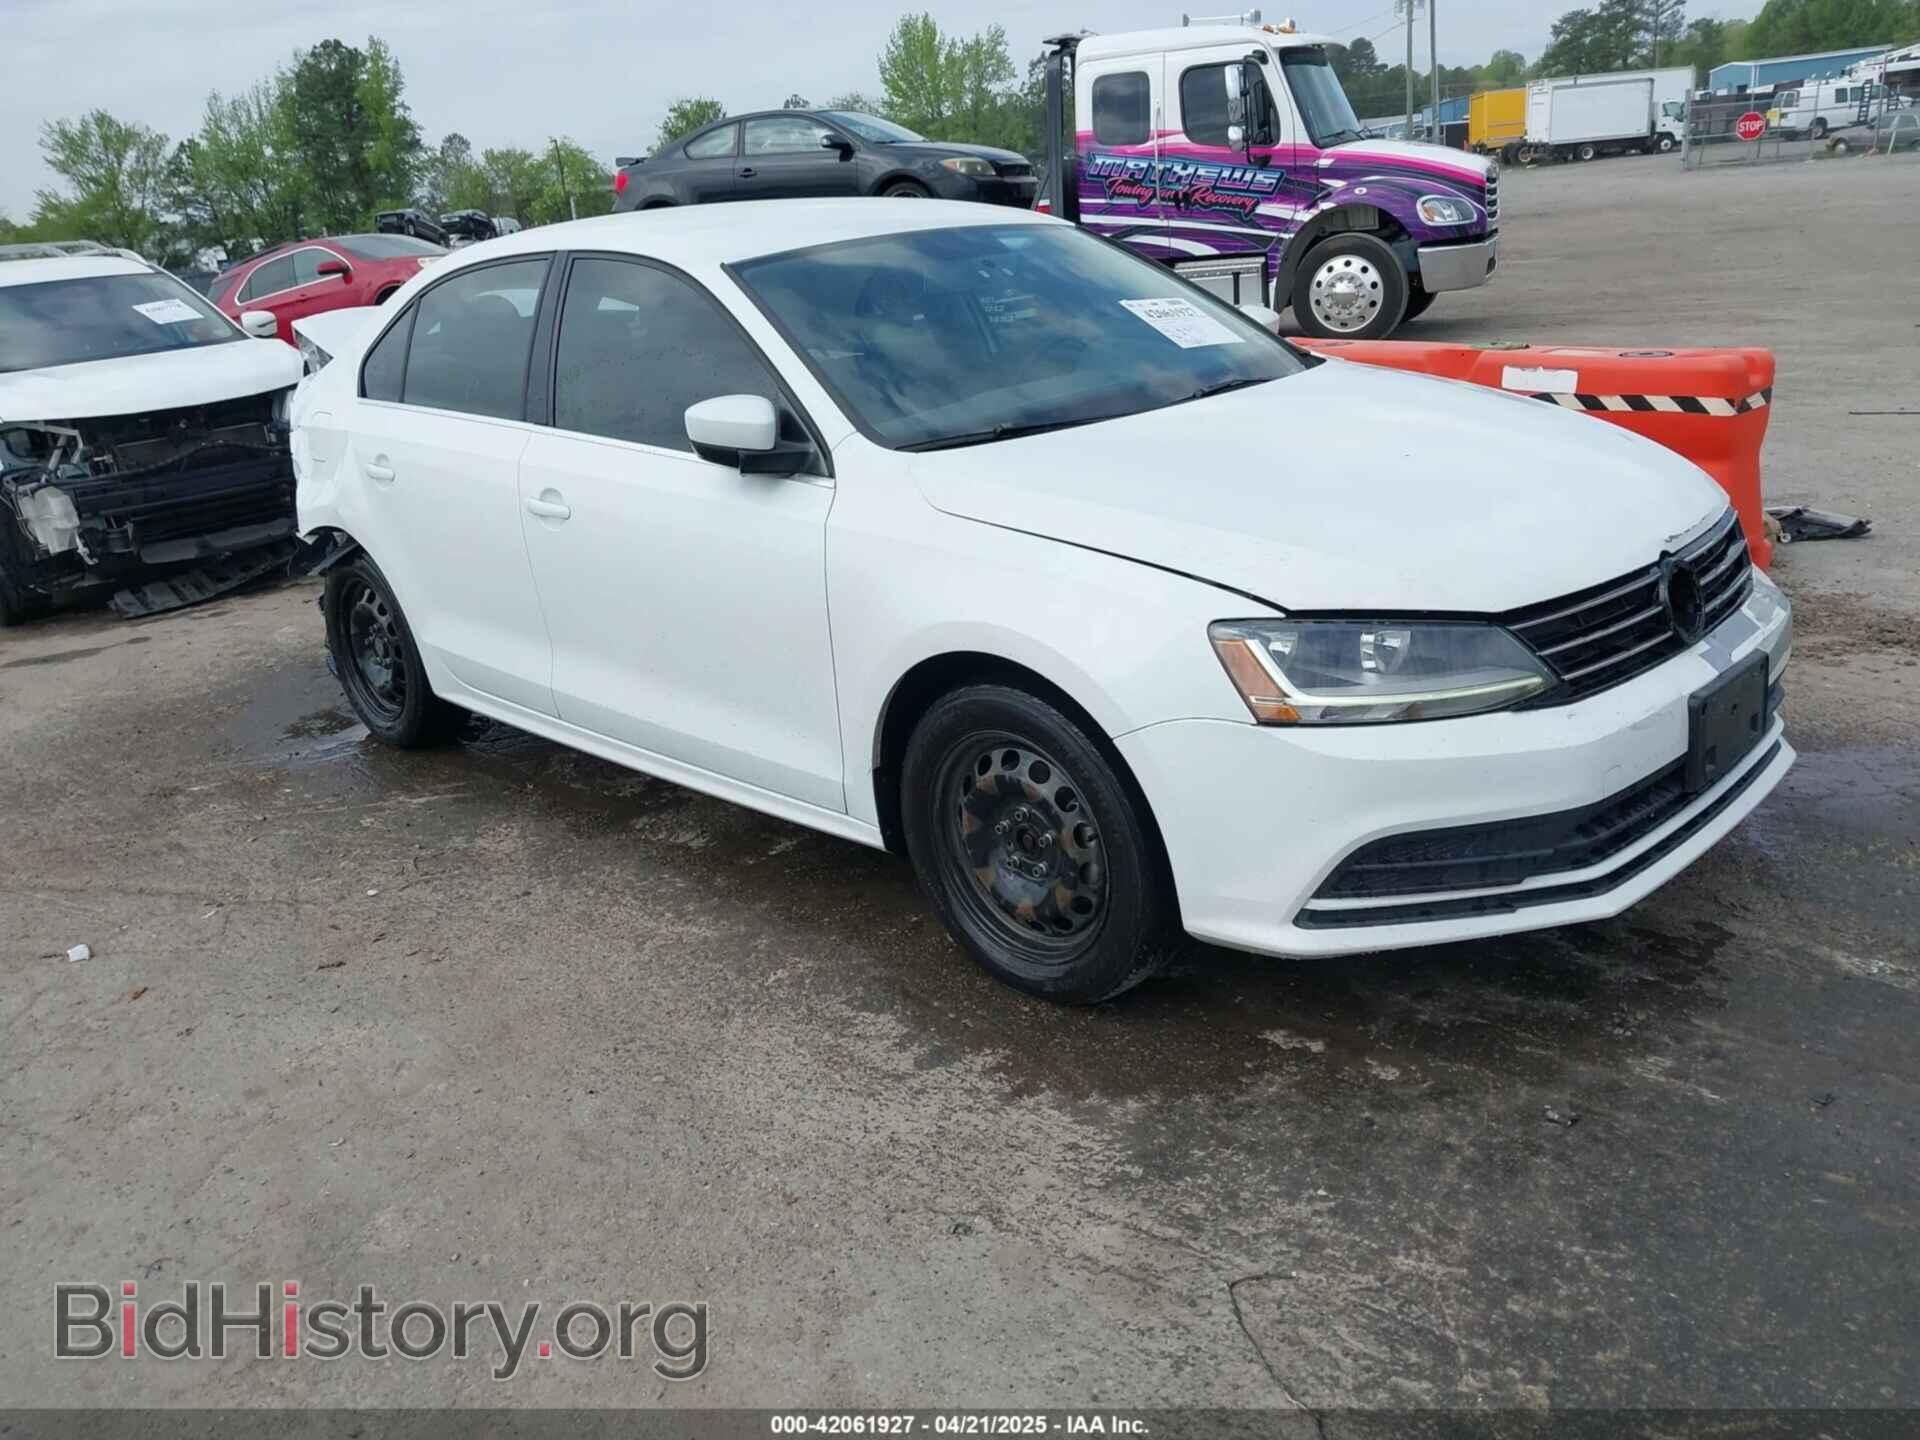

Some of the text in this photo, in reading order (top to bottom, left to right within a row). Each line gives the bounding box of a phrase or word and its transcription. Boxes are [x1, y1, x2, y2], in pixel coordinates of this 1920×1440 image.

[1740, 121, 1763, 132] STOP
[1088, 154, 1283, 193] MATHEWS
[1107, 178, 1153, 201] Towing
[1189, 184, 1257, 213] Recovery
